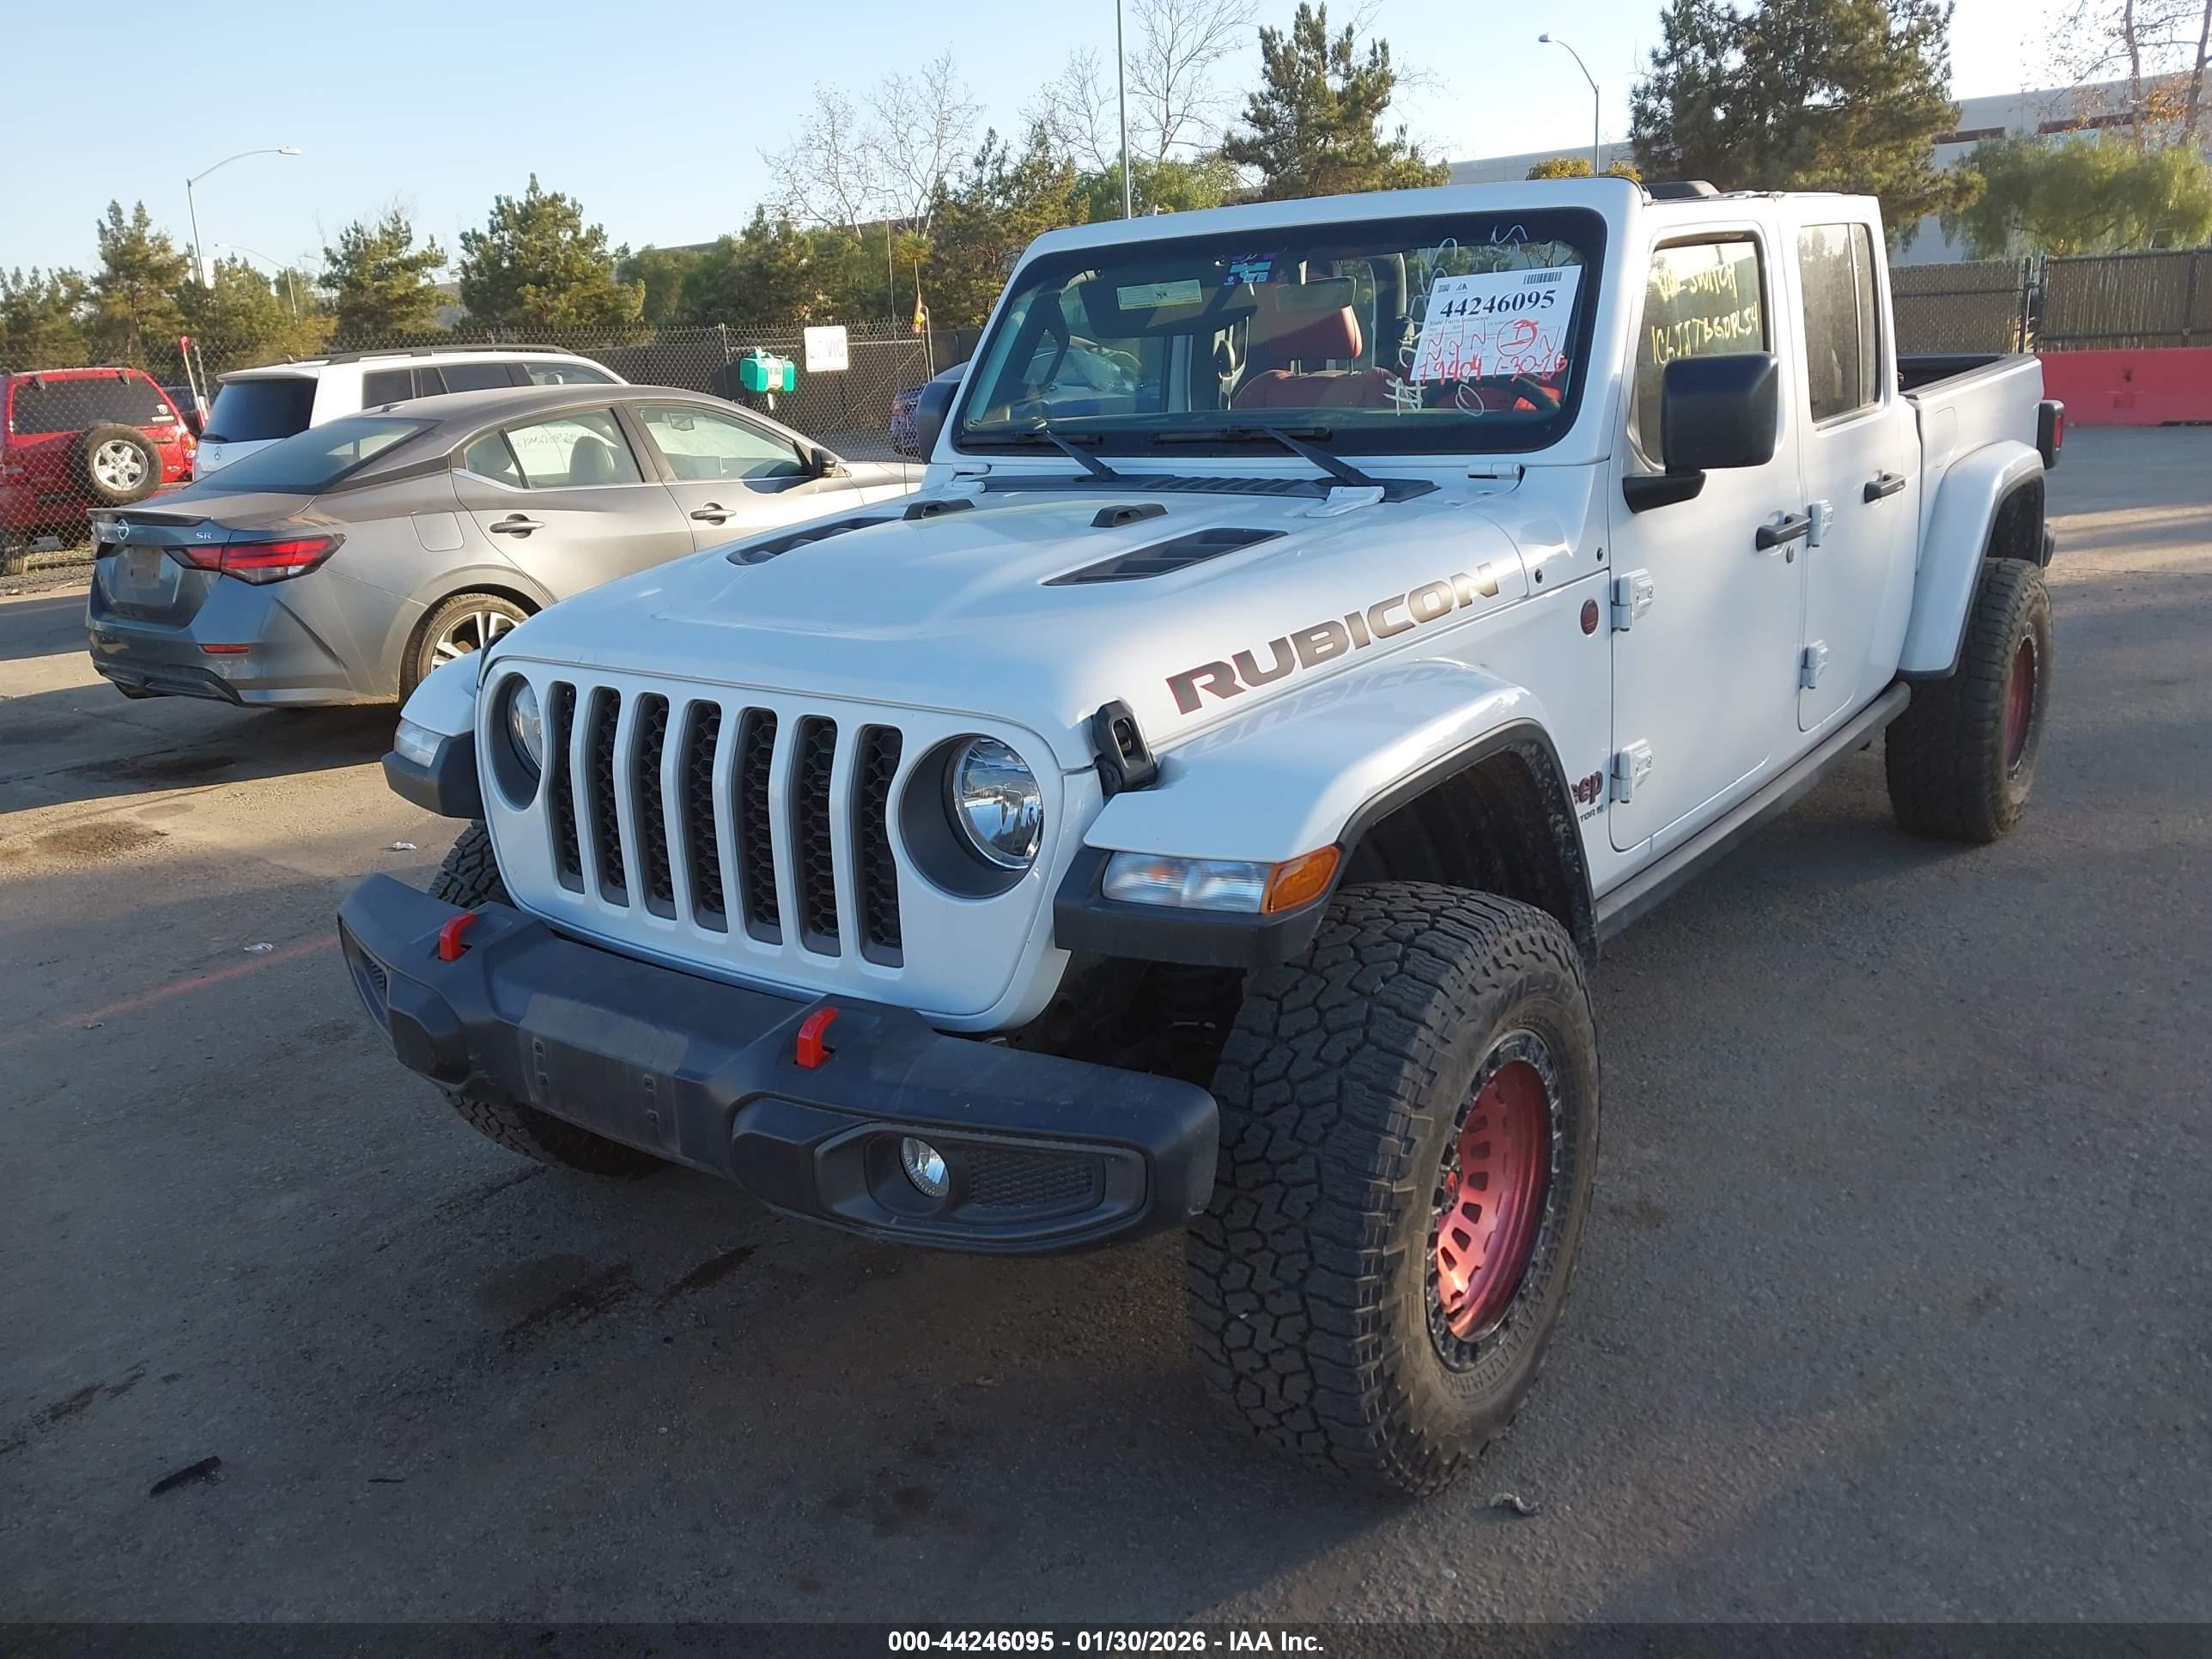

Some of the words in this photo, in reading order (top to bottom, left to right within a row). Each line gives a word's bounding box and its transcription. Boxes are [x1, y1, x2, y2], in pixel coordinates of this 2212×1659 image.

[1440, 289, 1556, 318] 44246095
[195, 532, 213, 540] SR
[1165, 562, 1500, 714] RUBICON
